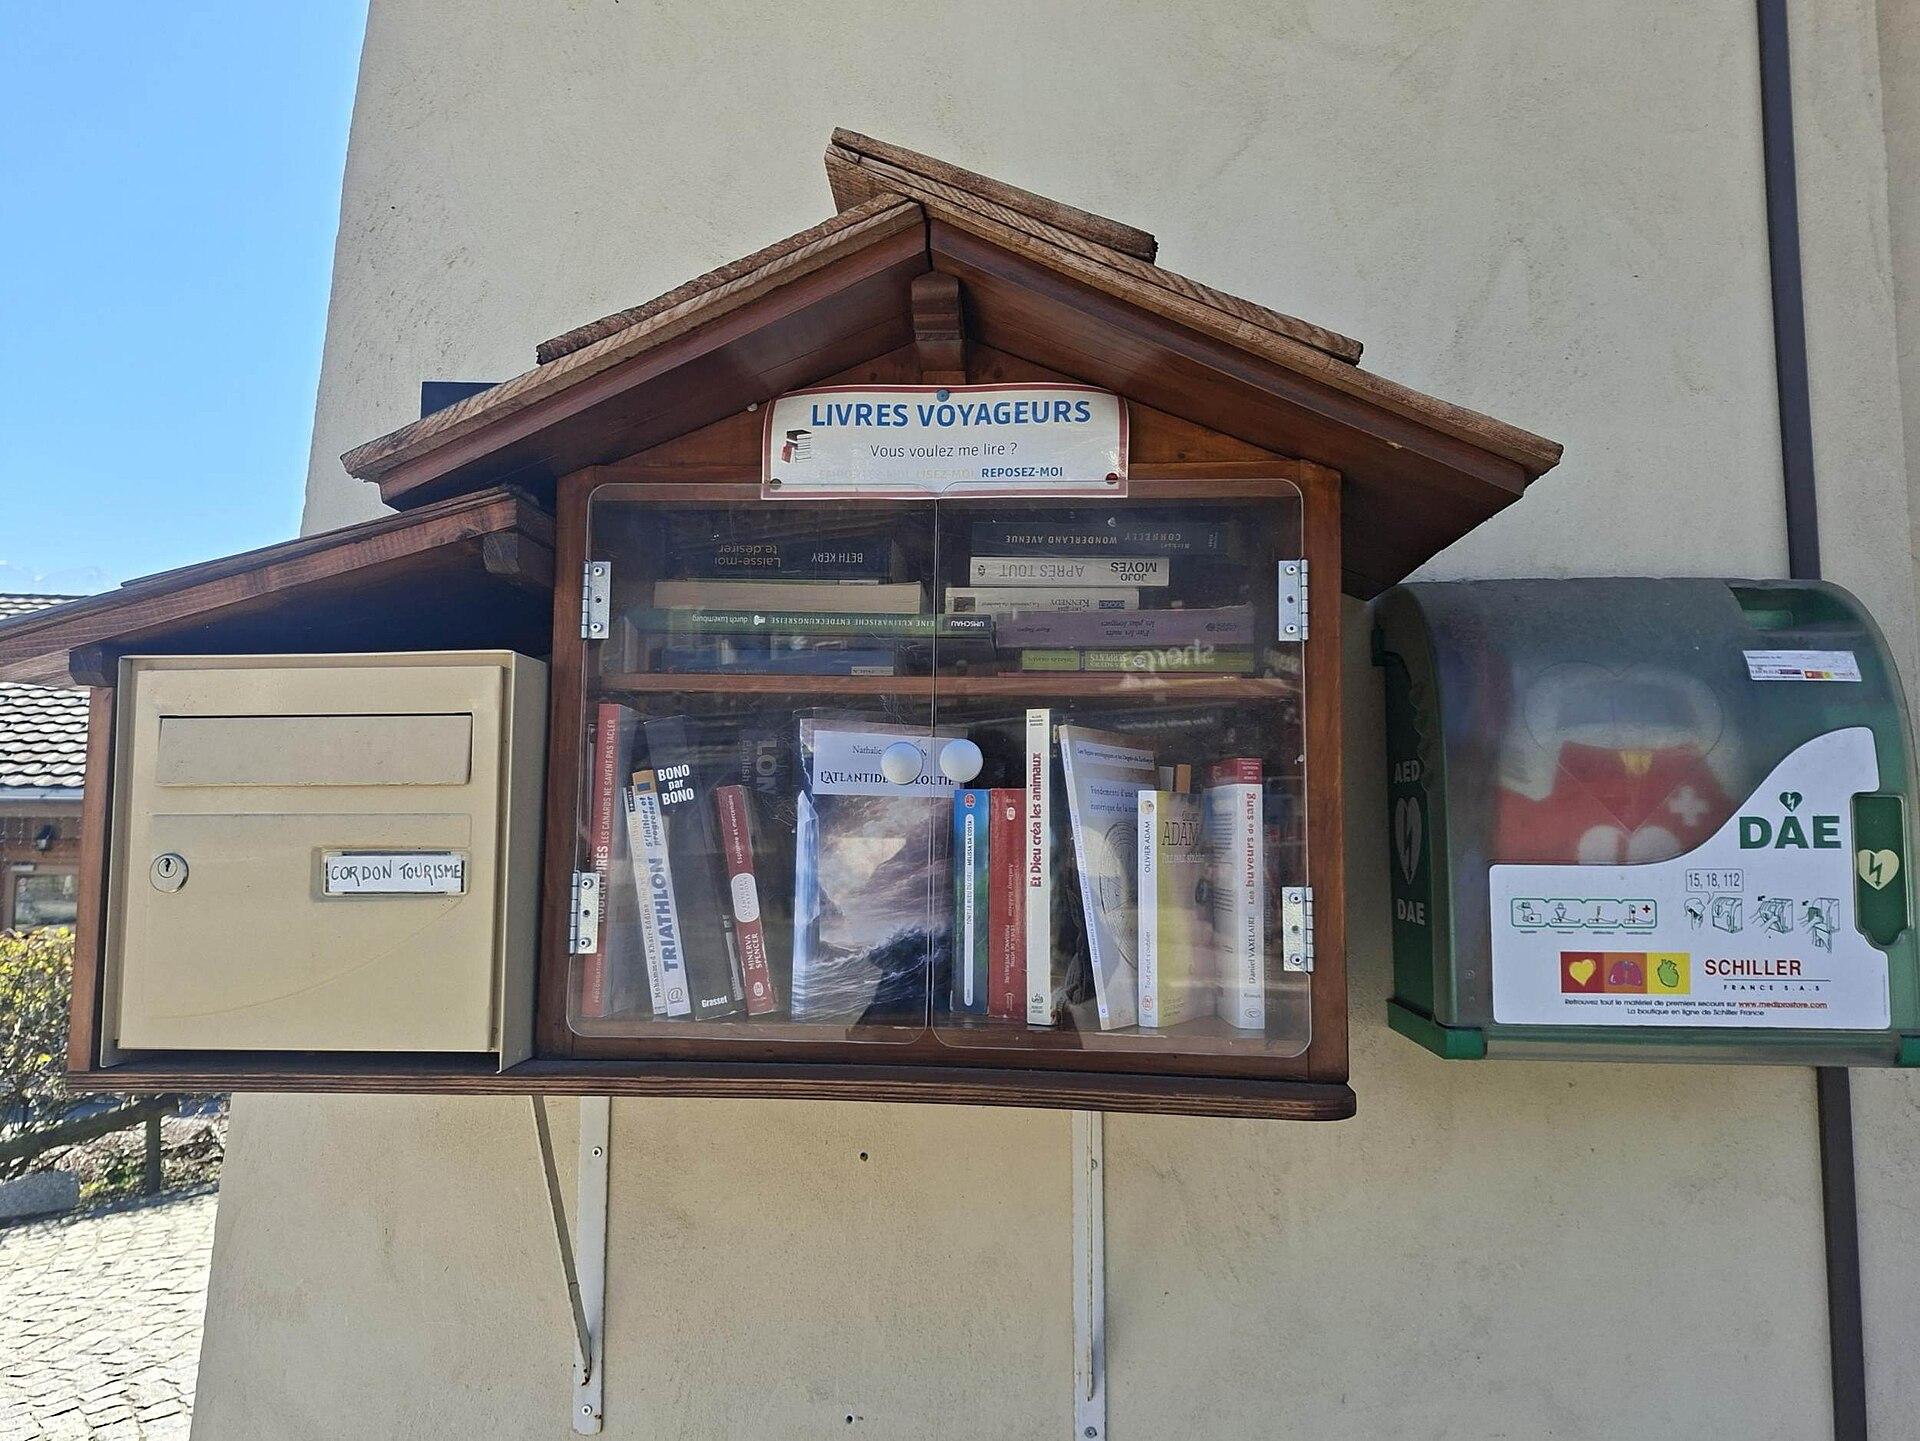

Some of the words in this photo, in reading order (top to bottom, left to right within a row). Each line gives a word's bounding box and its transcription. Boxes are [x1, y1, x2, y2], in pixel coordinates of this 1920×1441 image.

[811, 402, 908, 428] LIVRES
[916, 399, 1092, 428] VOYAGEURS
[870, 444, 905, 458] Vous
[909, 444, 953, 458] voulez
[957, 446, 979, 457] me
[984, 442, 1005, 456] lire
[1008, 442, 1017, 455] ?
[981, 466, 1064, 479] REPOSEZ-MOI
[1005, 534, 1046, 544] AVENUE
[1048, 534, 1118, 545] WONDERLAND
[1125, 532, 1182, 542] CONNELLY
[765, 544, 778, 556] te
[811, 551, 836, 563] KERY
[714, 555, 782, 569] Laisse-moi
[838, 552, 864, 563] BETH
[999, 563, 1038, 577] TOUT
[1041, 564, 1086, 580] APRÈS
[1110, 561, 1157, 574] MOYES
[1120, 573, 1148, 582] JOJO
[1050, 599, 1091, 610] KENNEDY
[692, 614, 728, 625] Luxemburg
[728, 615, 749, 624] durch
[771, 616, 851, 627] ENTDECKUNGSREISE
[854, 618, 915, 627] KULINARISCHE
[951, 620, 985, 628] UMSCHAU
[606, 719, 616, 745] TACLER
[605, 745, 615, 759] PAS
[852, 744, 882, 756] Nathalie
[604, 759, 614, 786] SAVENT
[658, 764, 690, 782] BONO
[1032, 752, 1043, 803] animaux
[1394, 760, 1420, 785] AED
[603, 786, 612, 797] NE
[668, 779, 684, 791] par
[662, 787, 695, 806] BONO
[601, 797, 611, 830] CANARDS
[1031, 803, 1042, 819] les
[1246, 792, 1257, 821] sang
[1031, 820, 1042, 846] créa
[1162, 821, 1200, 846] ADAM
[1246, 823, 1255, 835] de
[1739, 815, 1842, 850] DAE
[601, 830, 610, 844] LES
[967, 837, 973, 845] DA
[1030, 848, 1042, 875] Dieu
[1244, 837, 1255, 888] buveurs
[331, 860, 392, 887] CORDON
[400, 863, 461, 886] TOURISME
[1030, 876, 1041, 888] Et
[1688, 873, 1703, 889] 15,
[1706, 873, 1721, 888] 18,
[1724, 873, 1740, 887] 112
[648, 857, 679, 973] TRIATHLON
[1396, 898, 1426, 926] DAE
[1247, 915, 1256, 958] VAXELAIRE
[744, 934, 756, 970] MINERVA
[751, 932, 763, 970] SPENCER
[1247, 959, 1257, 985] Daniel
[1704, 959, 1802, 976] SCHILLER
[1723, 984, 1774, 992] FRANCE
[701, 995, 729, 1009] Grasset
[1564, 998, 1599, 1007] Retrouvez
[1600, 999, 1614, 1007] tout
[1615, 999, 1622, 1007] le
[1623, 999, 1653, 1008] matériel
[1654, 1000, 1665, 1008] de
[1666, 1000, 1696, 1009] premiers
[1738, 1001, 1828, 1010] www.mediprostore.com
[1637, 1008, 1670, 1017] boutique
[1682, 1009, 1700, 1018] ligne
[1701, 1009, 1713, 1017] de
[1713, 1009, 1739, 1017] Schiller
[1740, 1009, 1766, 1017] France
